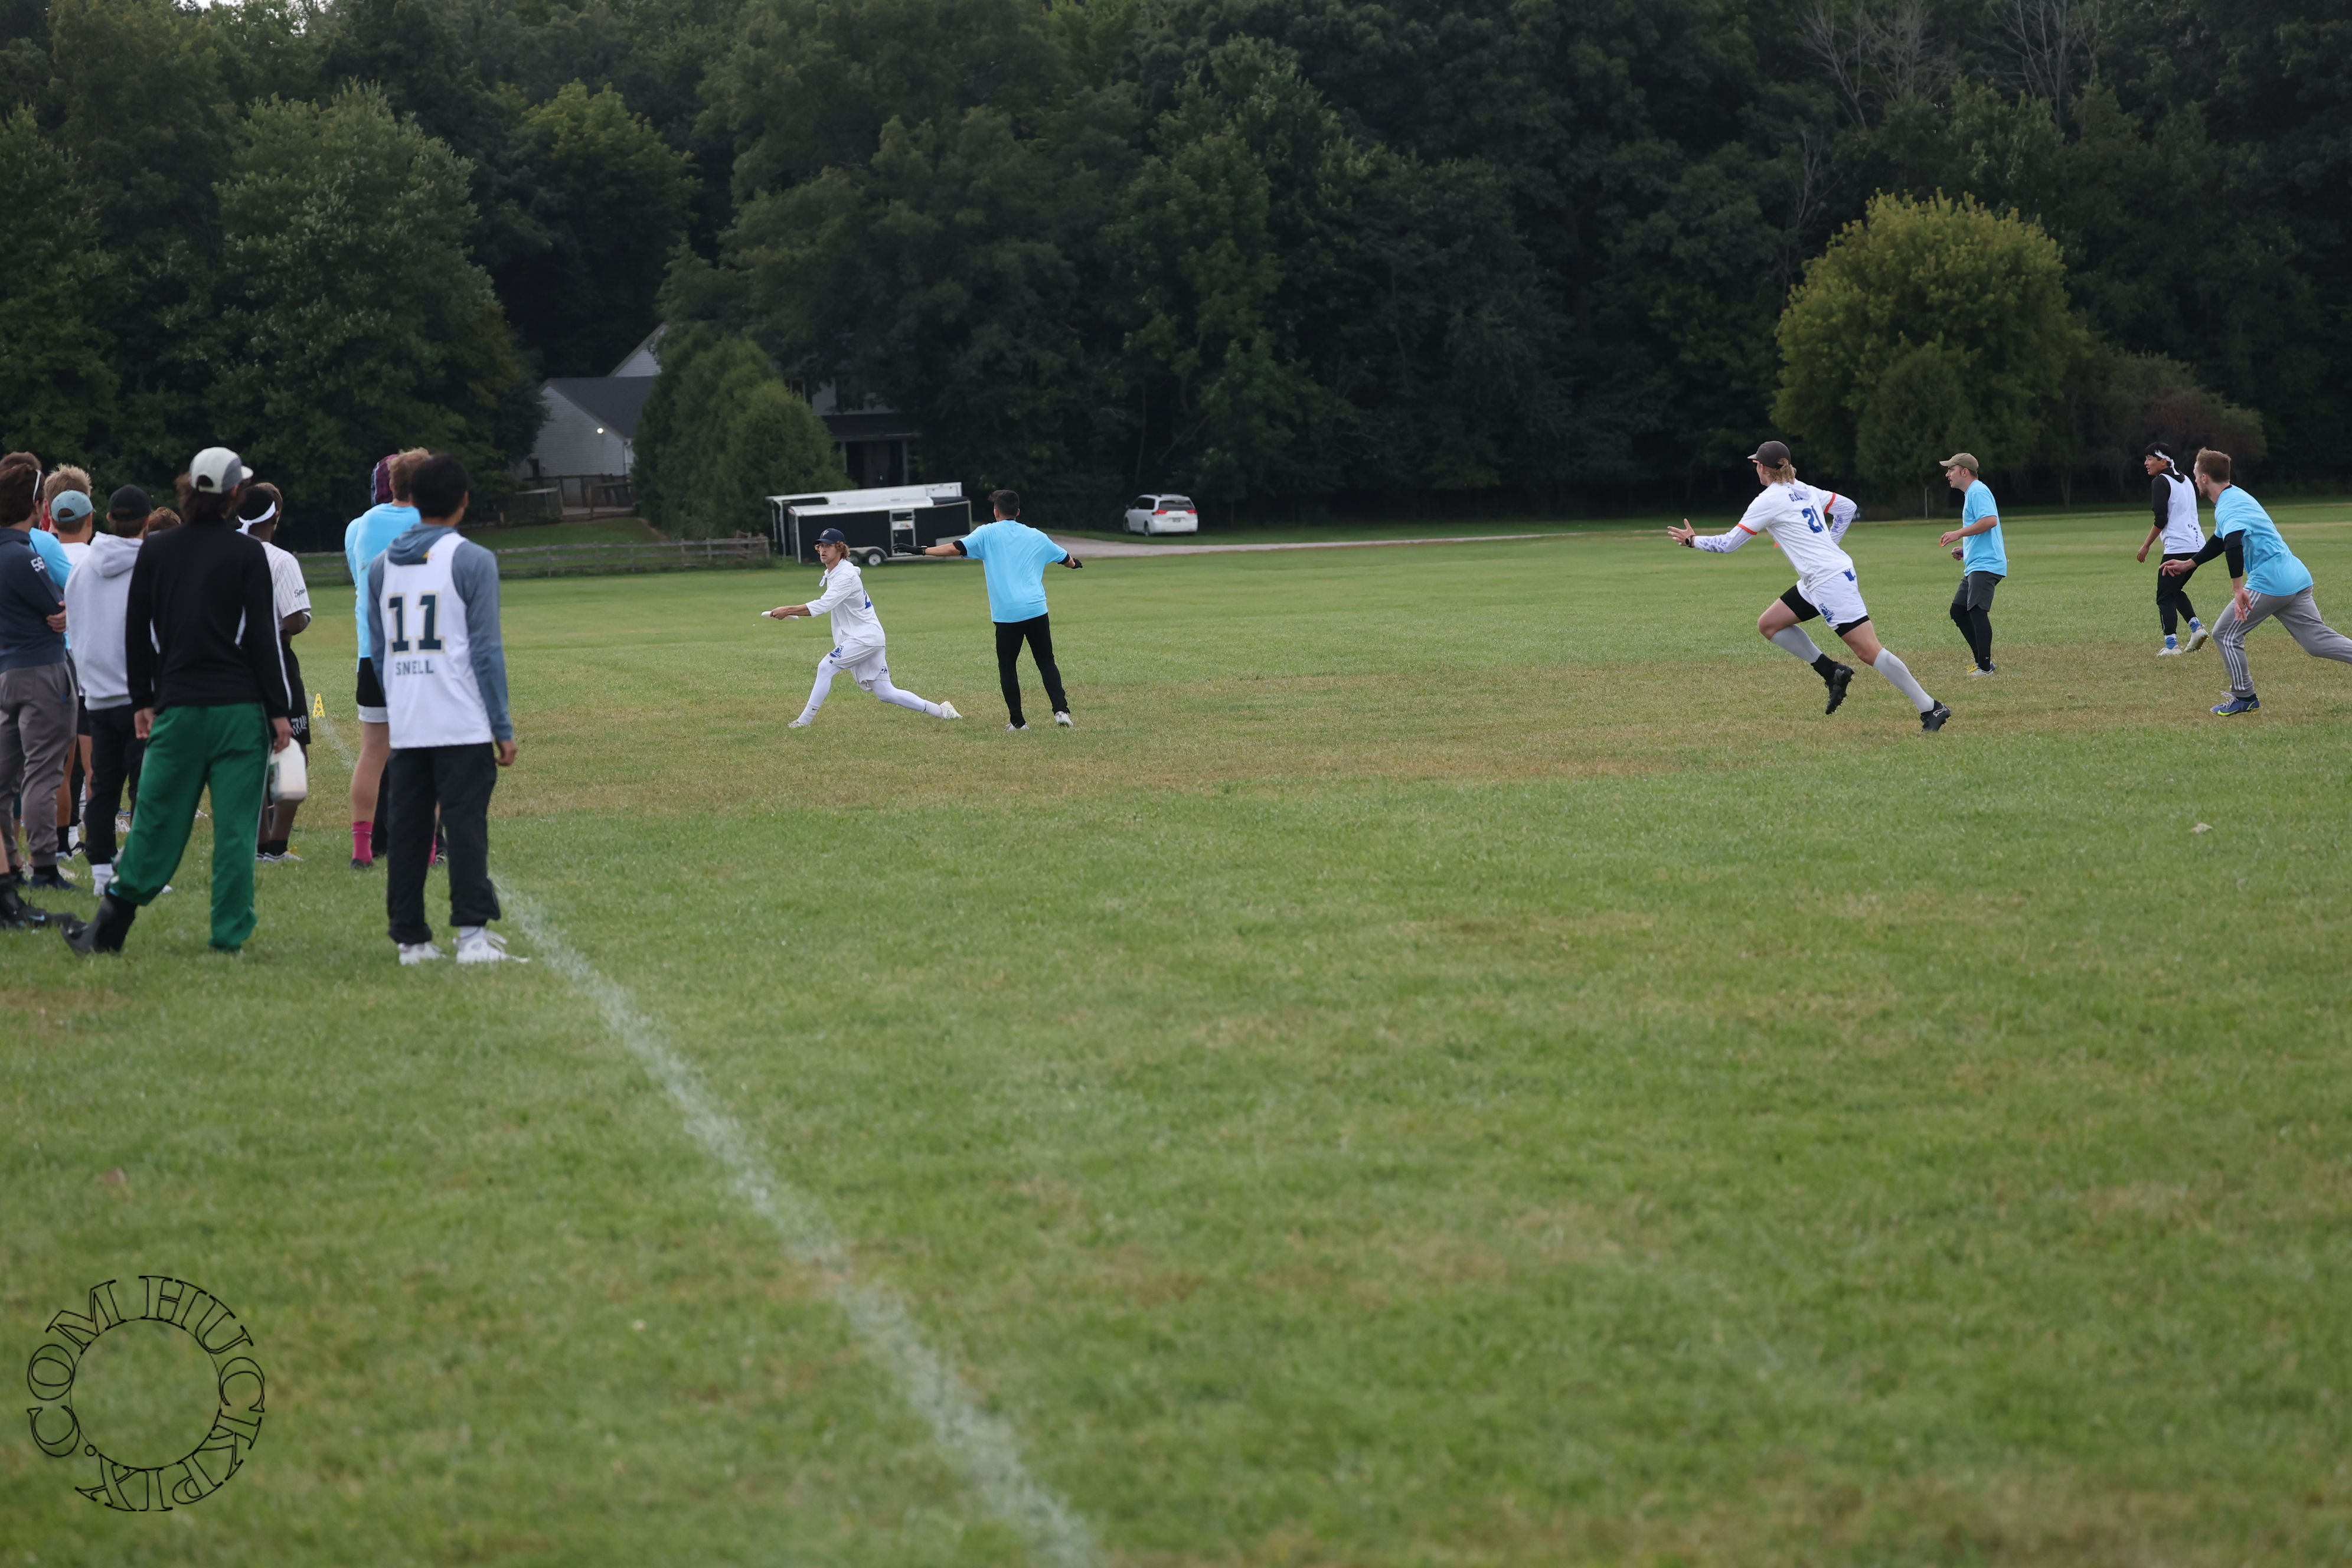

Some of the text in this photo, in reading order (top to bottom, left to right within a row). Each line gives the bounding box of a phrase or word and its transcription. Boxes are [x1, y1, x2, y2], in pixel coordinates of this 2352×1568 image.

[1802, 505, 1825, 534] 21
[387, 590, 446, 656] 11
[395, 658, 434, 675] SNELL
